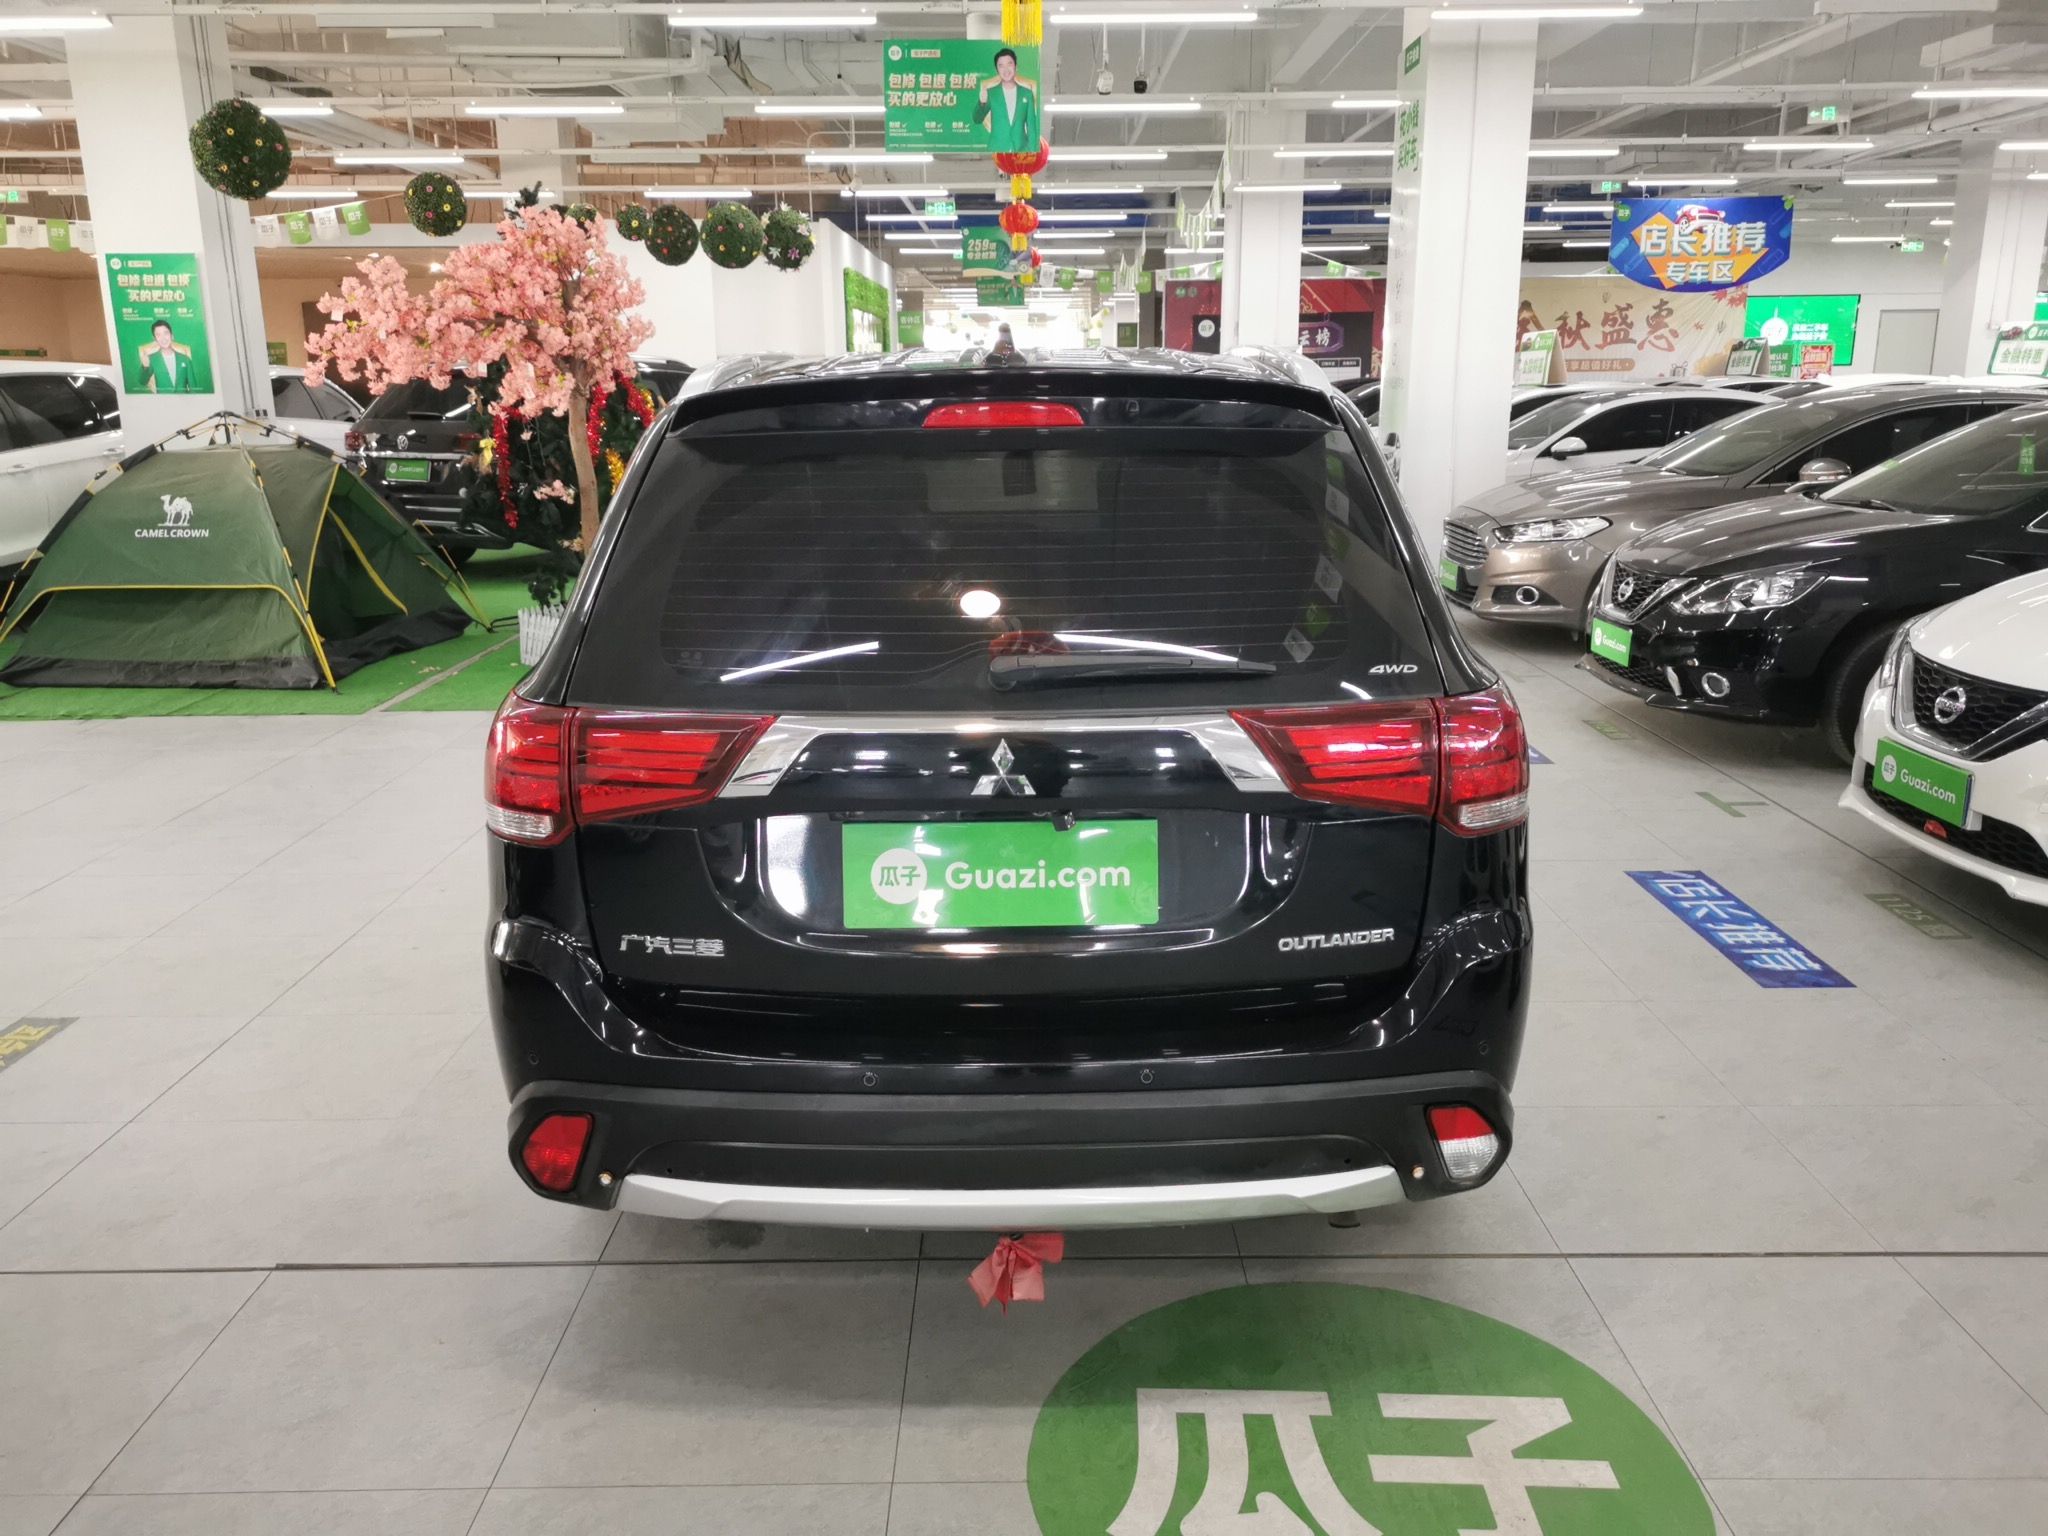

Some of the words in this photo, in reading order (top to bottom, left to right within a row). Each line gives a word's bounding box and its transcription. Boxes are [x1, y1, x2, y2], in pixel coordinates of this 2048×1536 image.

[887, 91, 957, 108] 买的更放心
[1640, 221, 1767, 257] 店长推荐
[1666, 261, 1734, 285] 专车区
[128, 289, 186, 302] 买的更放心
[1368, 664, 1419, 674] 4WD
[1900, 767, 1956, 805] Guazi.com
[878, 865, 921, 887] 瓜子
[945, 859, 1132, 890] Guazi.com
[619, 934, 725, 957] 广汽三菱
[1278, 927, 1395, 951] OUTLANDER
[1104, 1386, 1622, 1536] 瓜子
